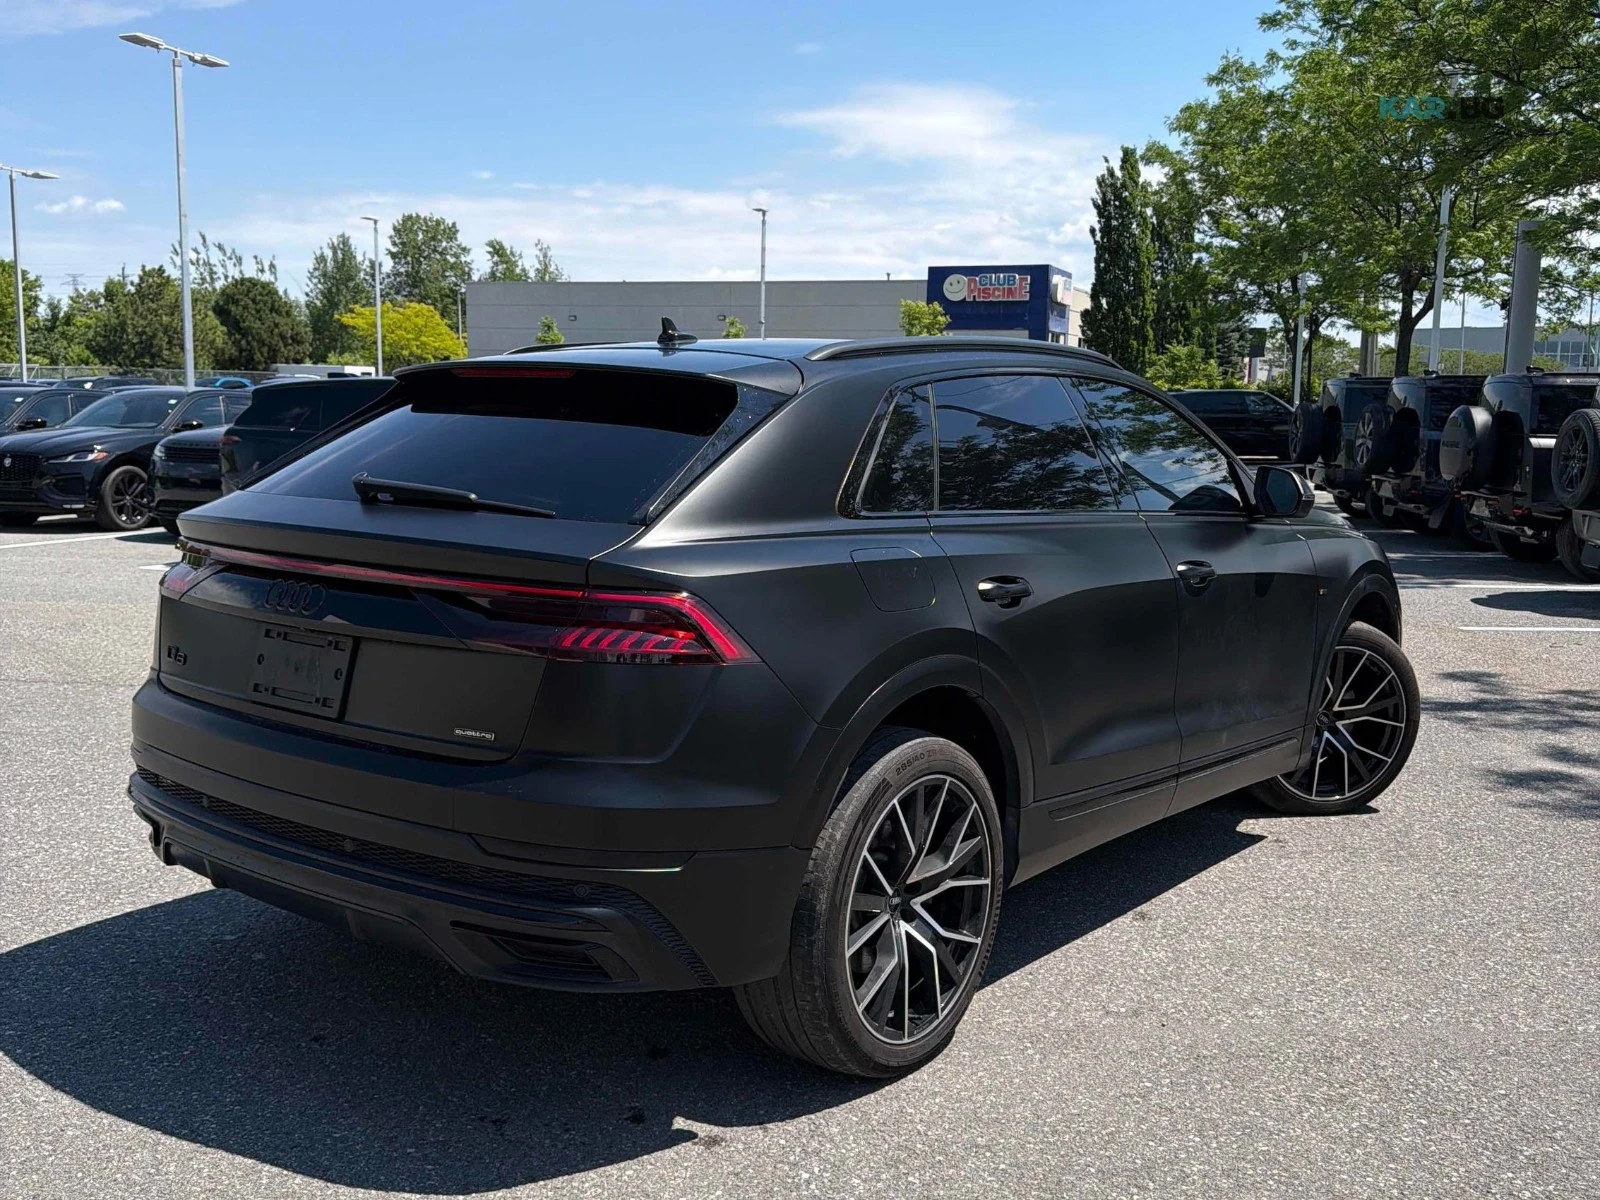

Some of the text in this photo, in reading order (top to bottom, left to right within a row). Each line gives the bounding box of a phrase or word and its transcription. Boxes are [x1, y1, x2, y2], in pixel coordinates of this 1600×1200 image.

[978, 274, 1018, 288] CLUB
[966, 276, 1030, 301] PISCINE
[454, 728, 493, 740] quattro
